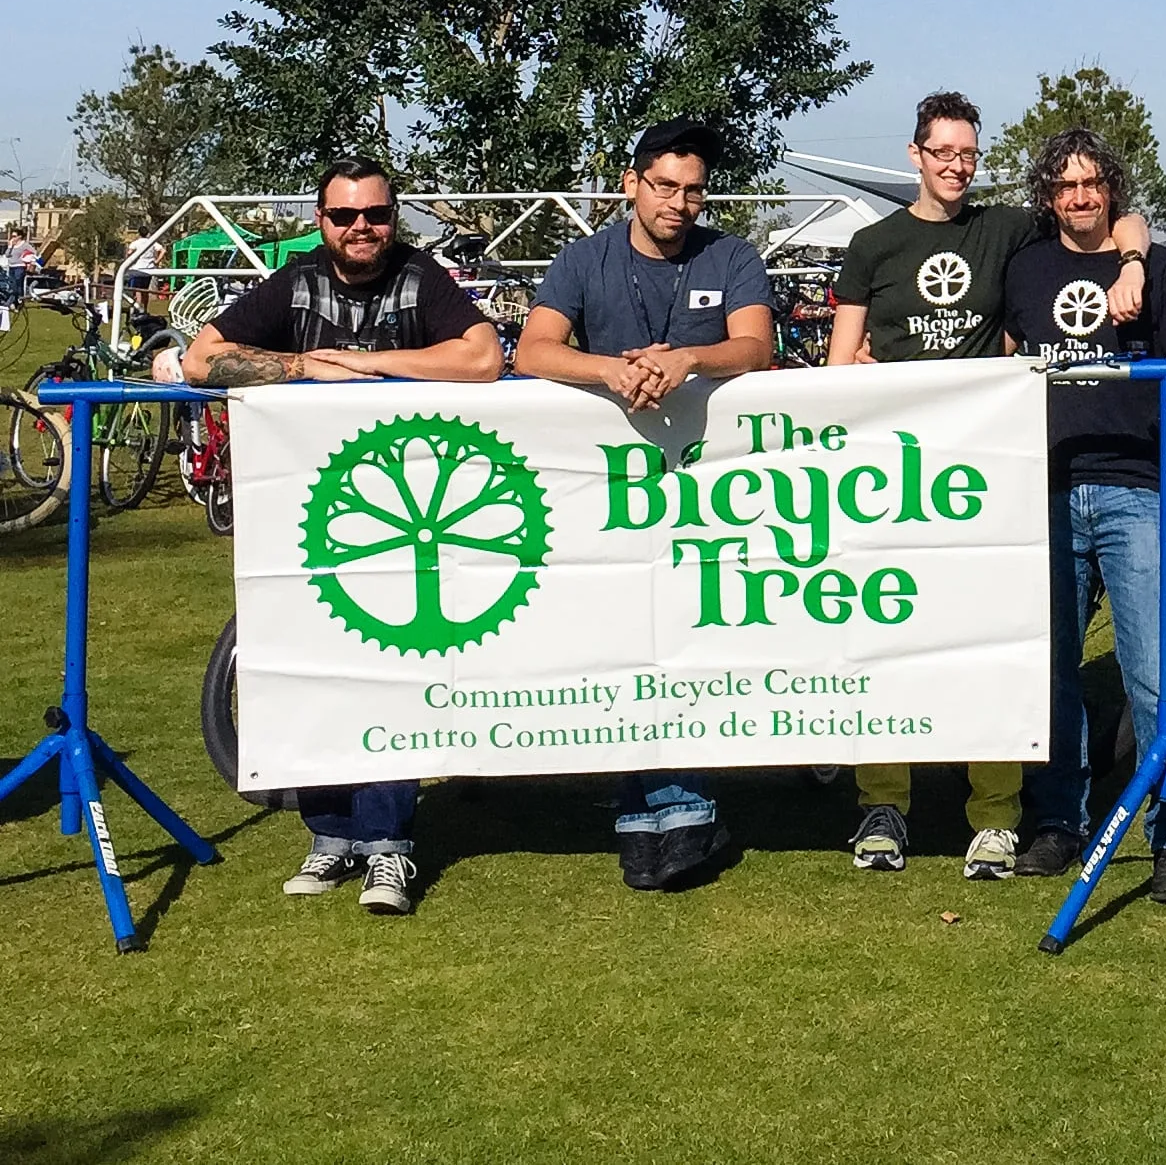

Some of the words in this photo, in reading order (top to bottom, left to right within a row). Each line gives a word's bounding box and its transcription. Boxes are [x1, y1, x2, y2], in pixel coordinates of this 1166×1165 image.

[906, 309, 983, 339] Bicycle
[934, 308, 959, 318] The
[1064, 337, 1089, 350] The
[737, 413, 849, 454] The
[596, 430, 989, 569] Bicycle
[671, 536, 919, 629] Tree
[423, 679, 622, 713] Community
[633, 674, 752, 703] Bicycle
[764, 670, 871, 696] Center
[361, 726, 479, 754] Centro
[489, 712, 707, 749] Comunitario
[718, 712, 758, 739] de
[771, 710, 934, 739] Bicicletas
[1101, 805, 1131, 845] Park
[1079, 843, 1108, 884] Tool
